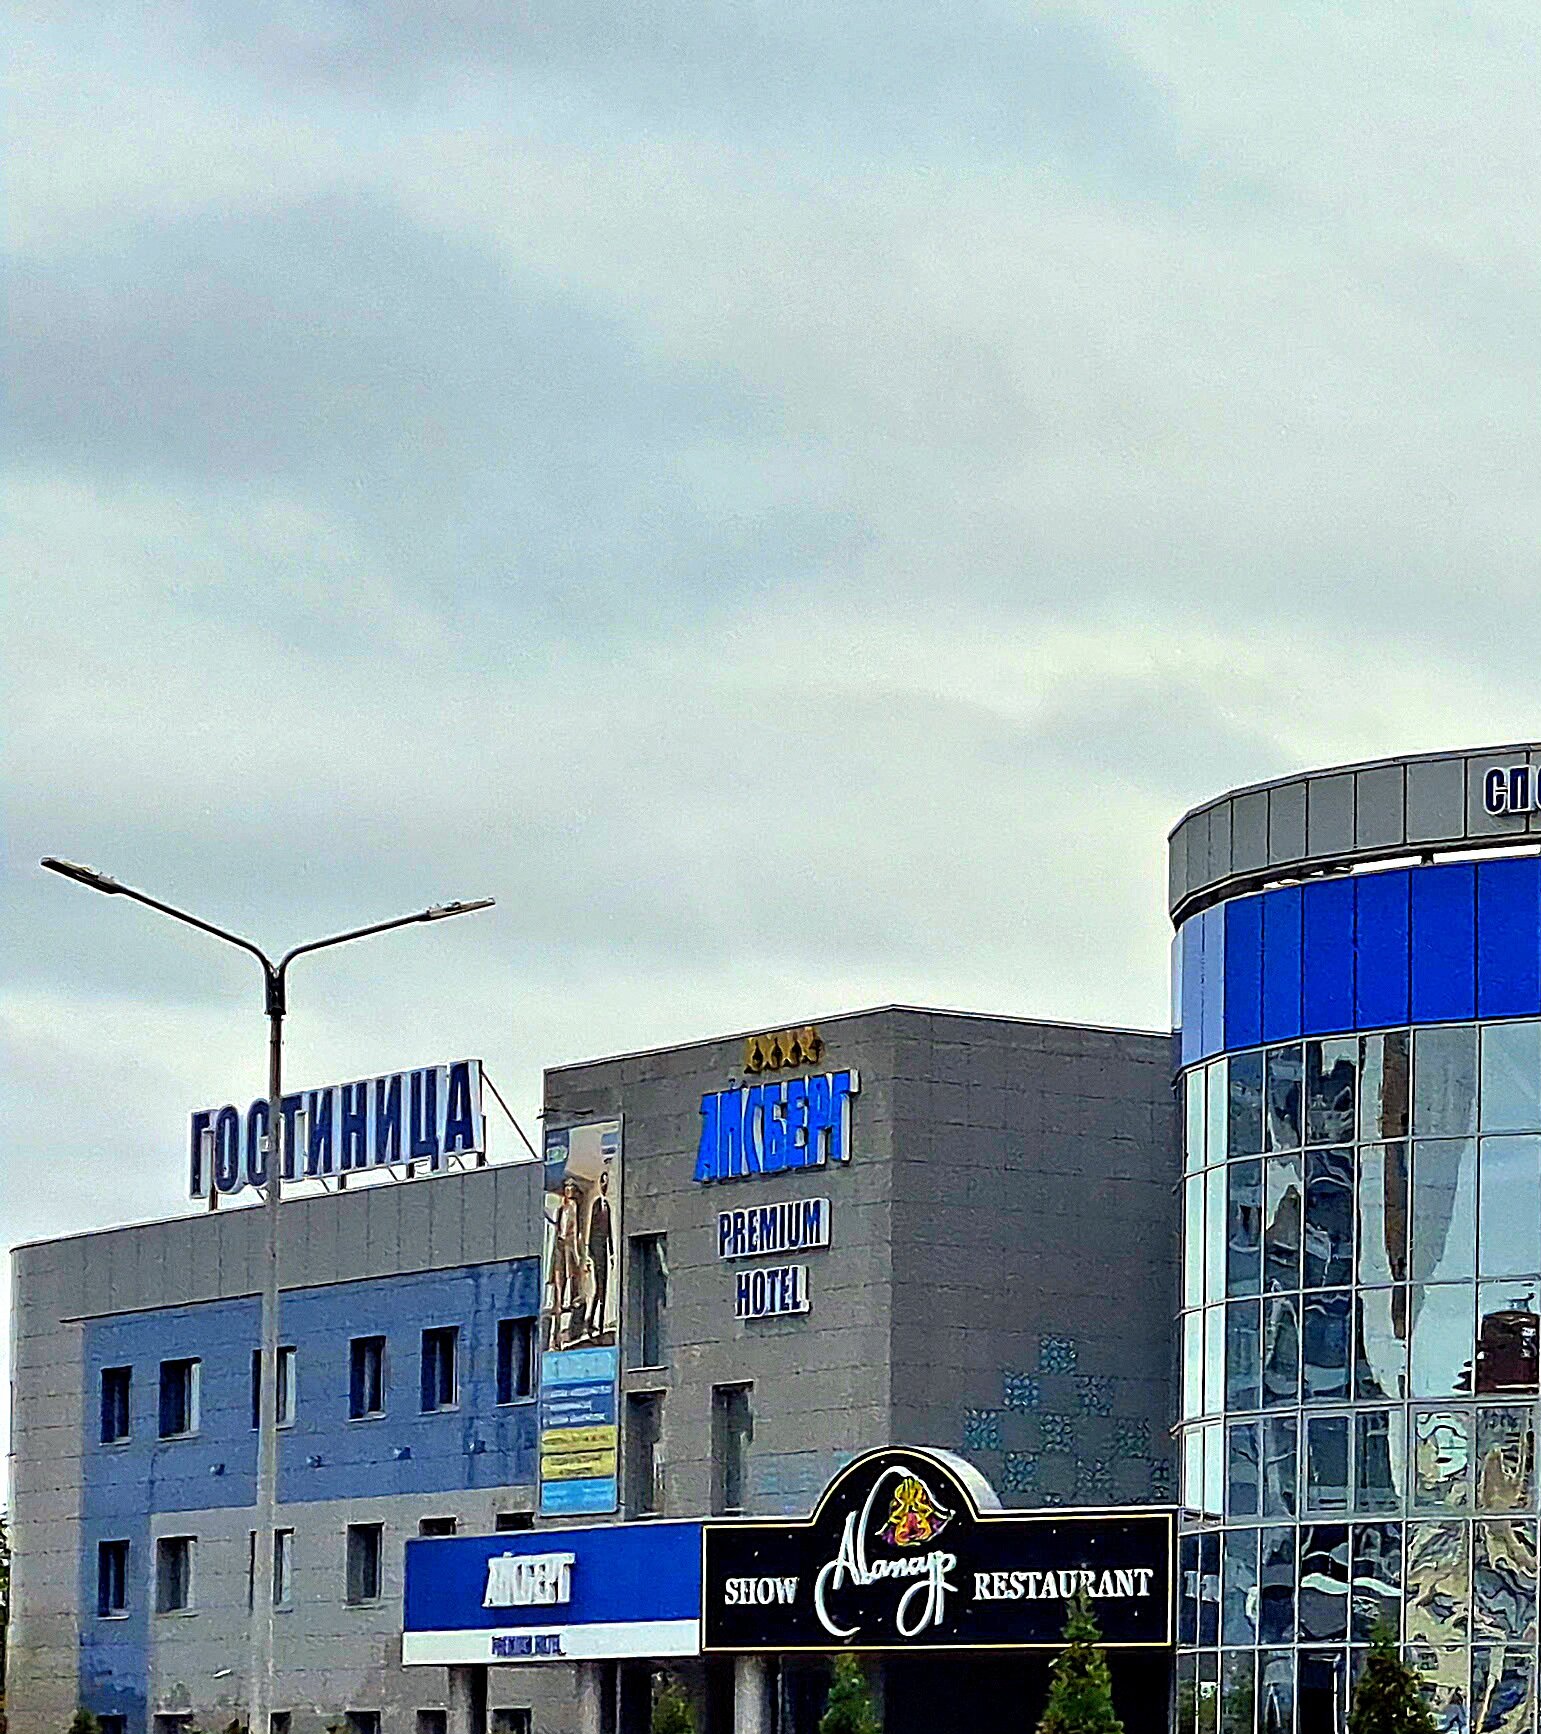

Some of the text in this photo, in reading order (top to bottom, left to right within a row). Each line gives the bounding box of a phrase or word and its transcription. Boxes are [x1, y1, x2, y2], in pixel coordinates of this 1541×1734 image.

[190, 1061, 479, 1199] ГОСТИНИЦА
[718, 1197, 831, 1259] PREMIUM
[735, 1264, 809, 1320] HOTEL
[724, 1567, 1153, 1606] SHOW RESTAURANT
